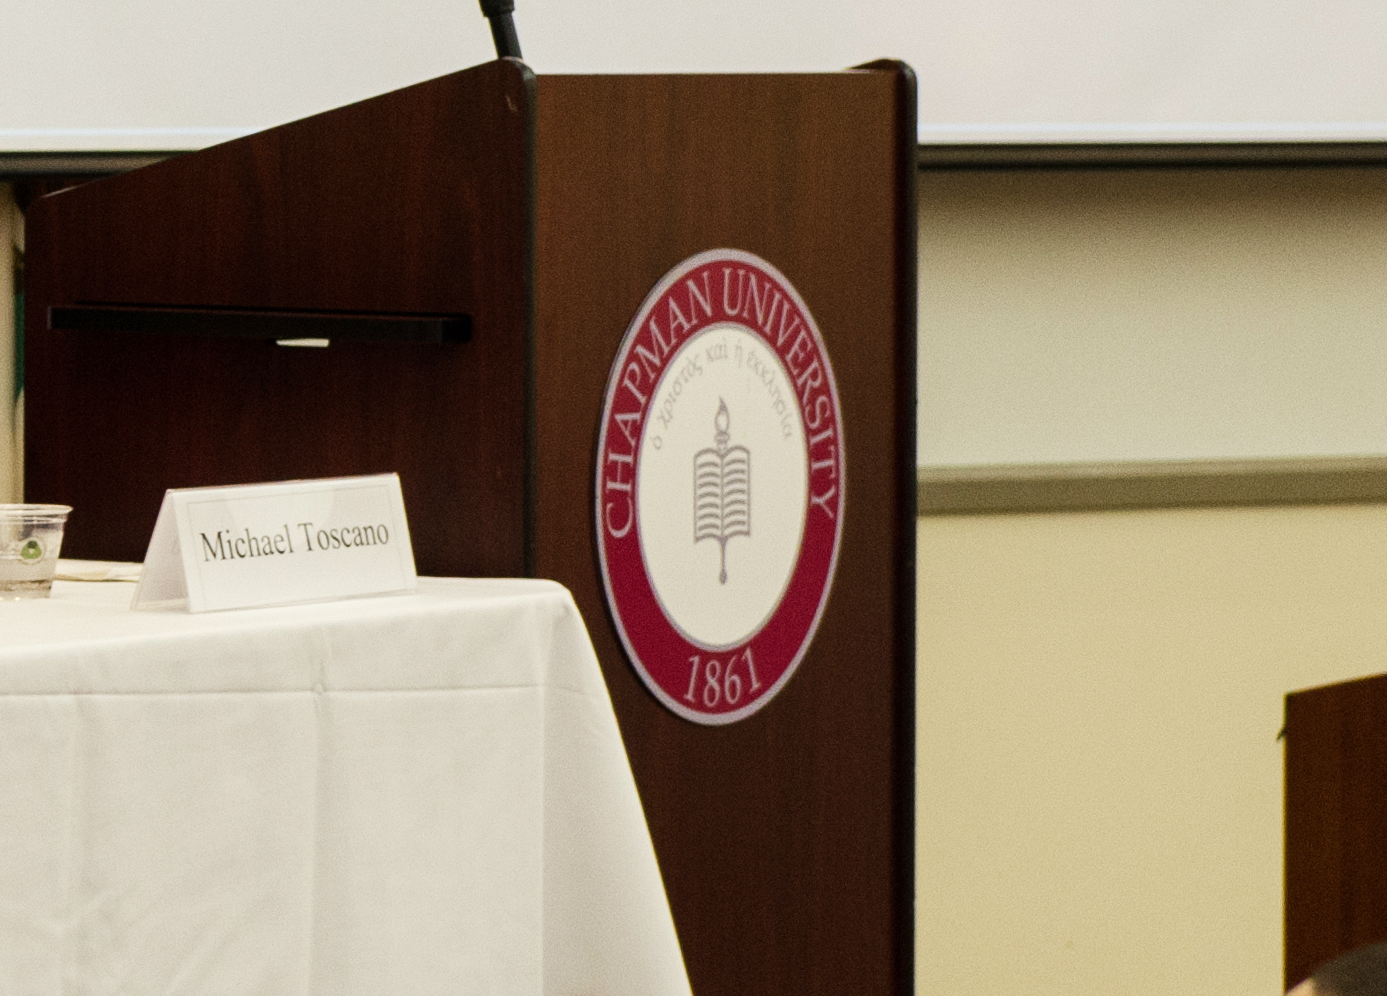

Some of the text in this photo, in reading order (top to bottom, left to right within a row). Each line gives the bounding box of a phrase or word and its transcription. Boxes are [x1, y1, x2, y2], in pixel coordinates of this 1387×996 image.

[606, 266, 836, 539] CHAPMAN UNIVERSITY
[199, 522, 389, 562] Michael Toscano
[683, 647, 762, 708] 1861
